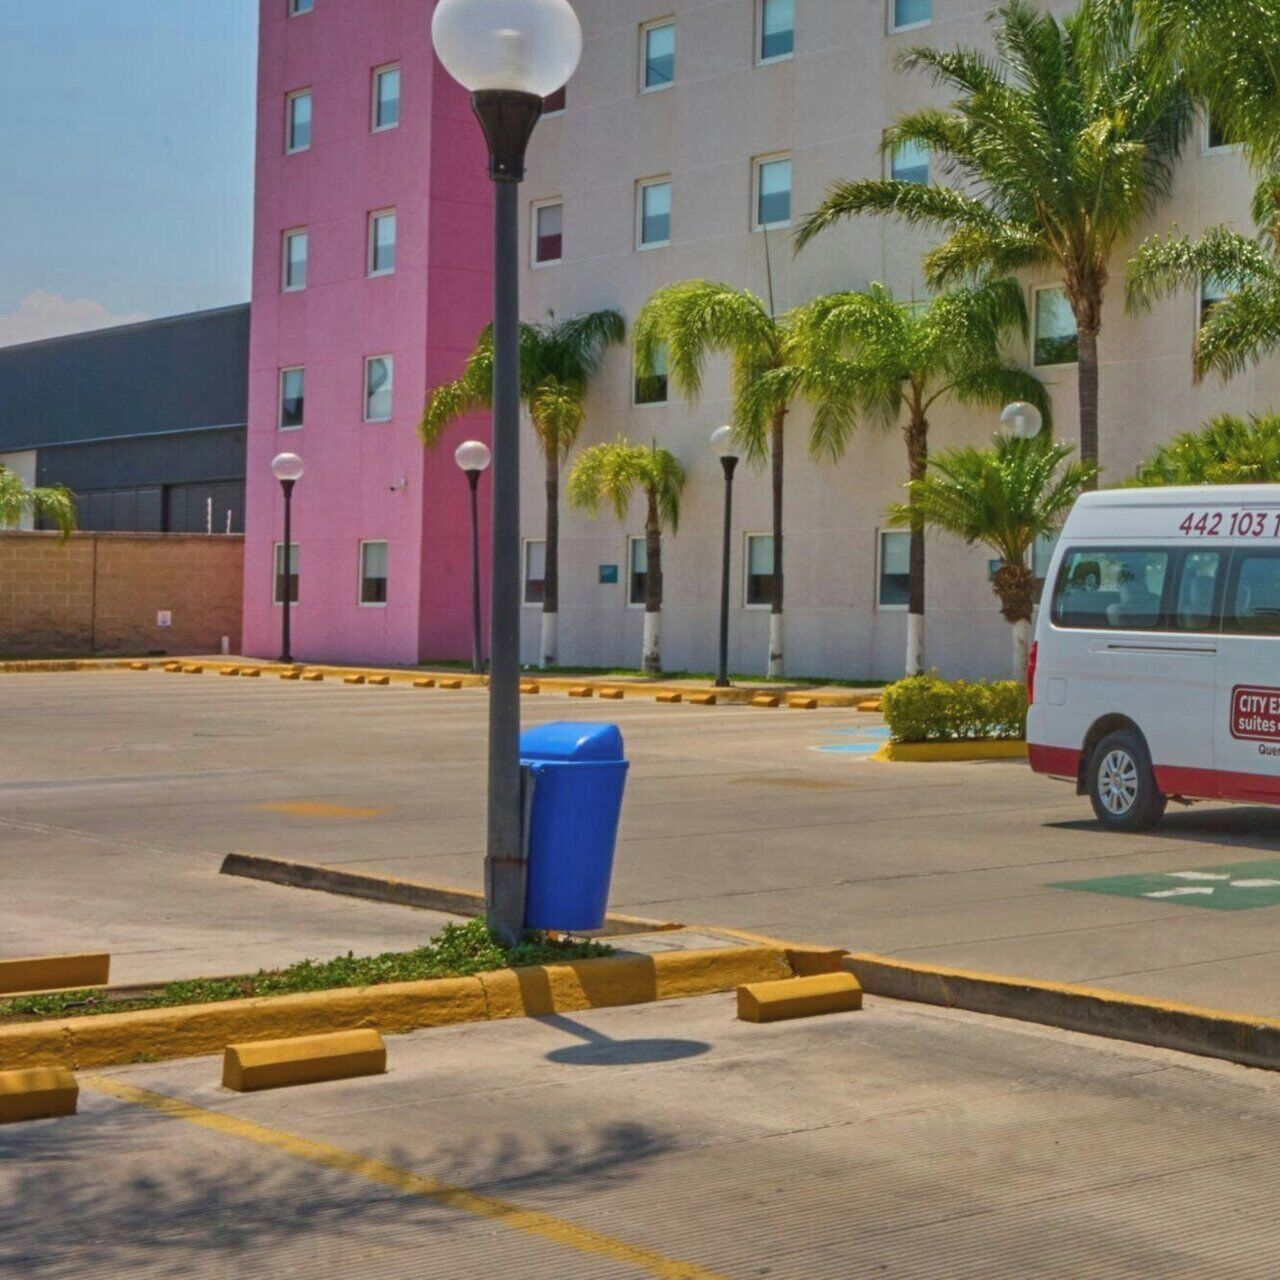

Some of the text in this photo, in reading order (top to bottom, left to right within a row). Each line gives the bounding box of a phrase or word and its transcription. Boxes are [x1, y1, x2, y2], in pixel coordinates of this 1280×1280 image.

[1178, 512, 1223, 536] 442
[1229, 512, 1268, 537] 103
[1239, 695, 1267, 714] CITY
[1238, 715, 1276, 732] suites
